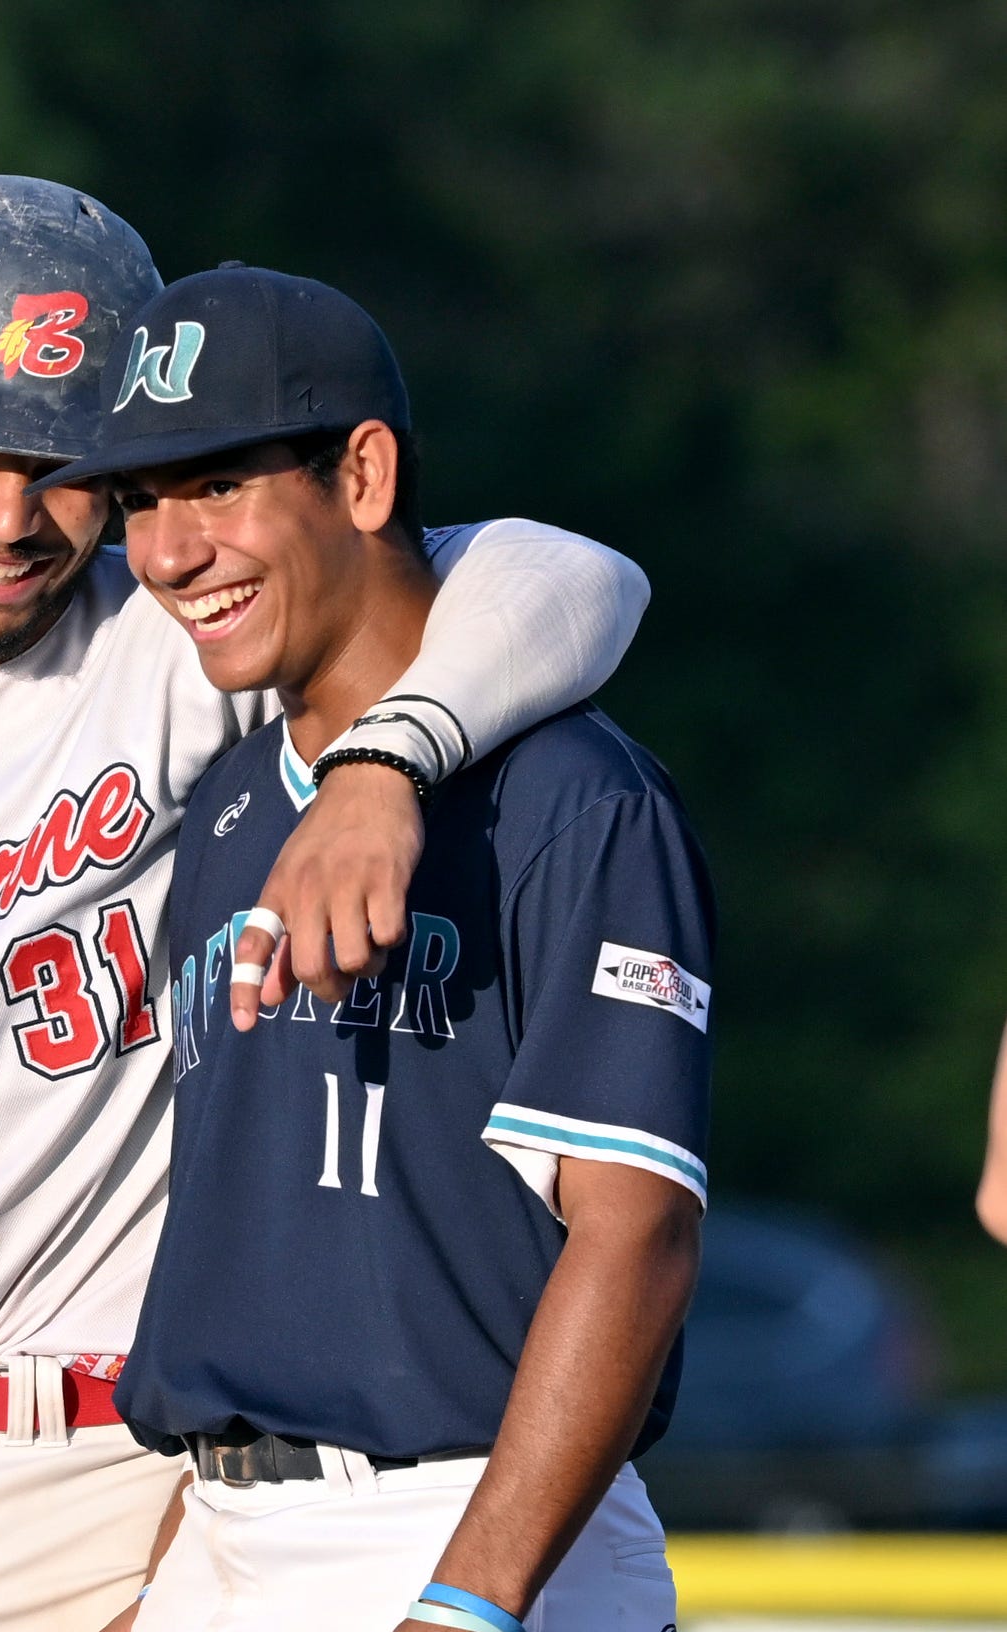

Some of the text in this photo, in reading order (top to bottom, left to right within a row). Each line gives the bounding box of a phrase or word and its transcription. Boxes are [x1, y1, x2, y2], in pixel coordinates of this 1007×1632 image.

[623, 961, 658, 984] CAPE
[621, 979, 670, 998] BASEBALL
[317, 1073, 386, 1197] 11
